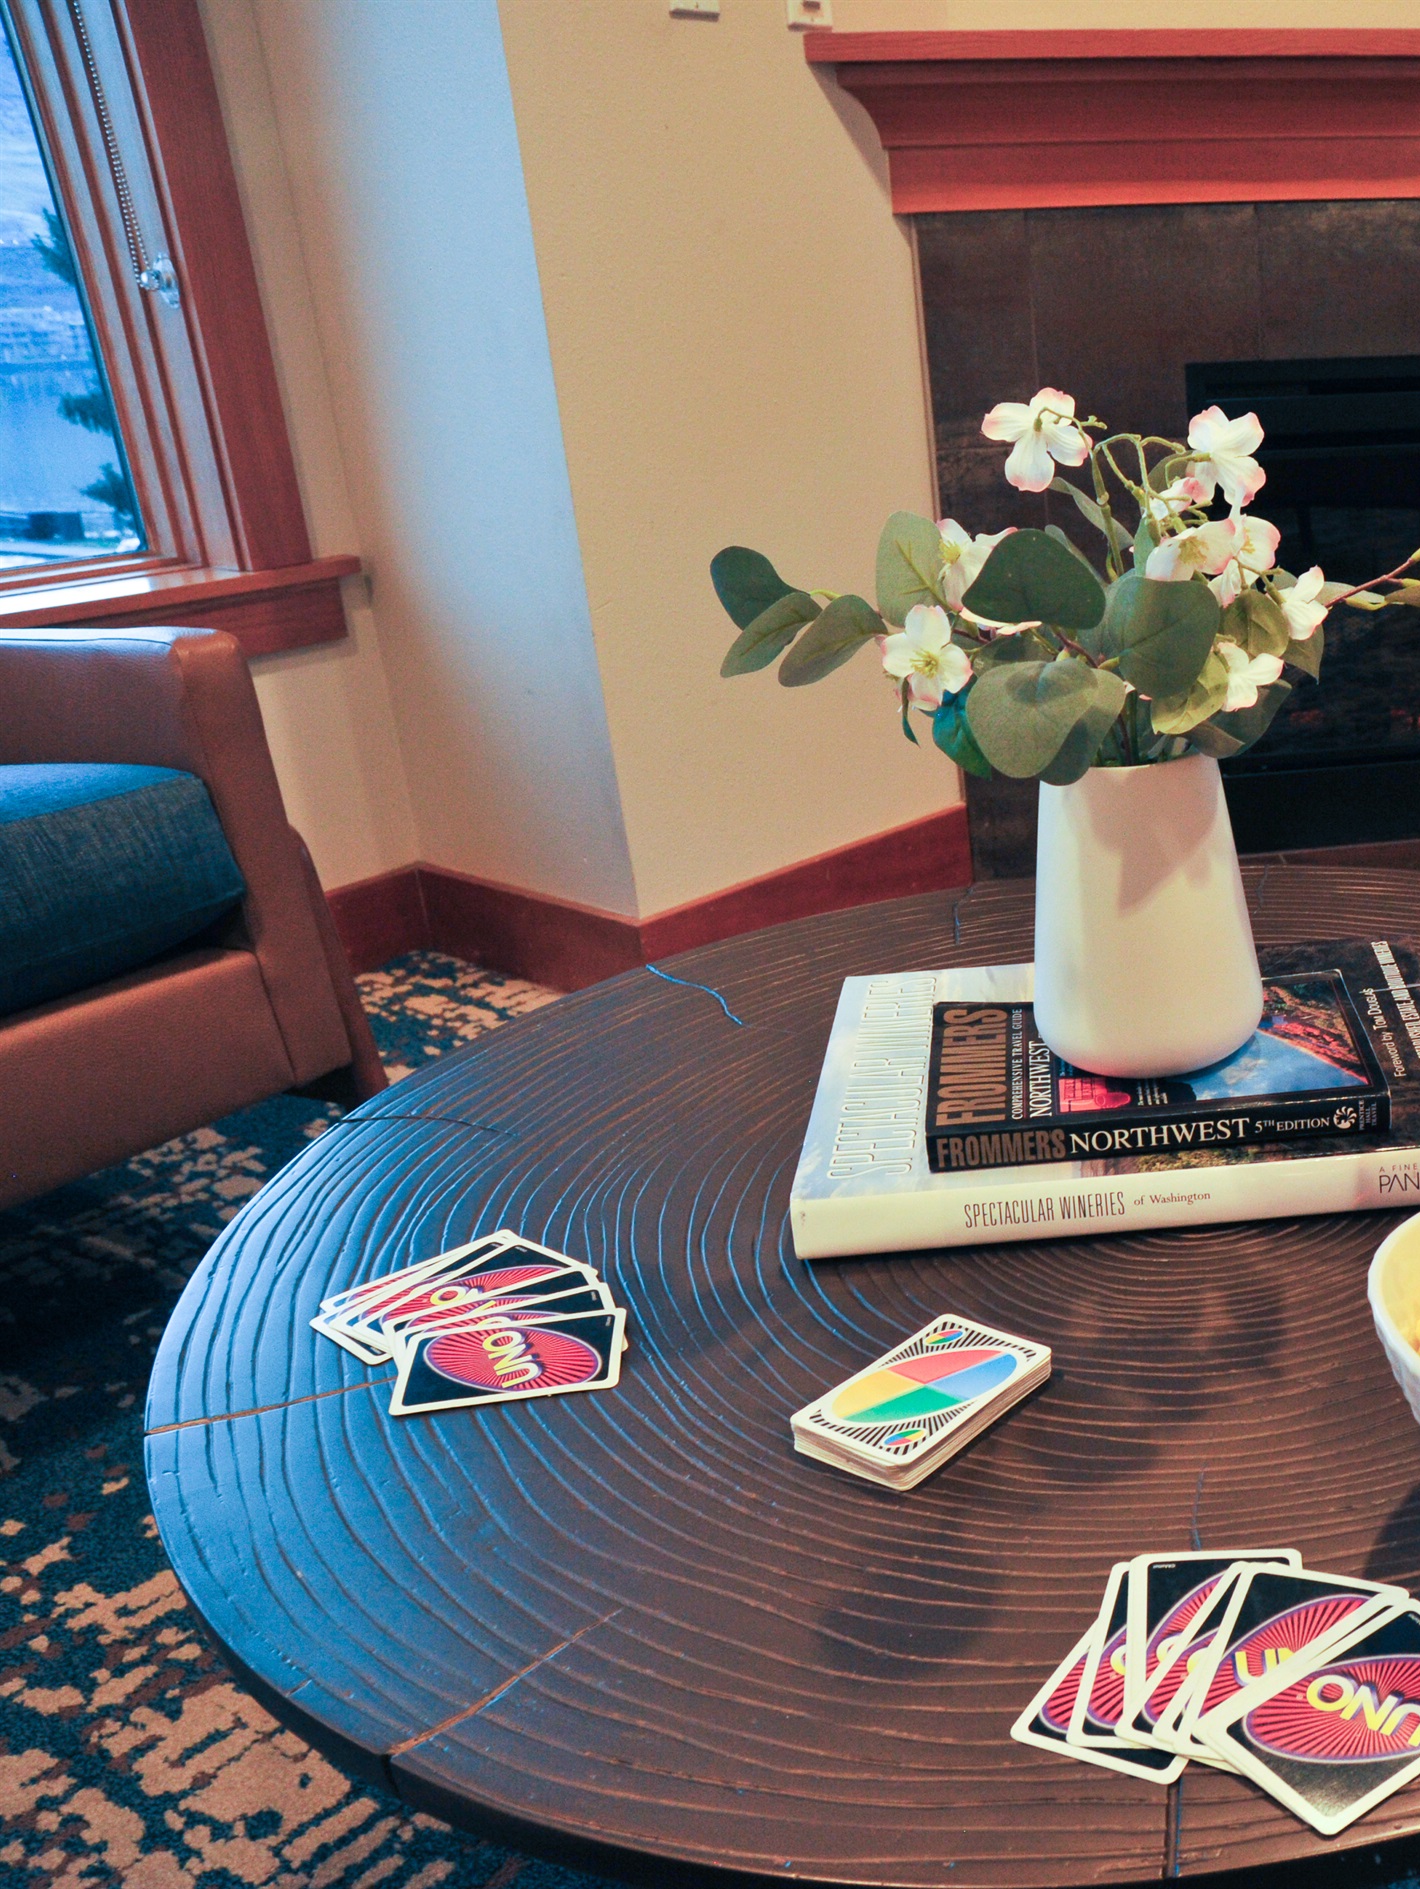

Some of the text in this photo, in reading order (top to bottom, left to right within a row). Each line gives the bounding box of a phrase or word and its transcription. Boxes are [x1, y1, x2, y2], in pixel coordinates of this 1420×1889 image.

[827, 976, 937, 1180] SPECTACULAR WINERIES
[1012, 1008, 1023, 1120] COMPREHENSIVE TRAVEL GUIDE
[1029, 1040, 1053, 1118] NORTHWEST
[1383, 1041, 1407, 1077] Foreword
[1069, 1117, 1250, 1154] NORTHWEST
[1276, 1116, 1330, 1132] EDITION
[1392, 1162, 1418, 1172] FINE
[964, 1190, 1211, 1229] SPECTACULAR WINERIES of Washington
[482, 1330, 540, 1389] UNO
